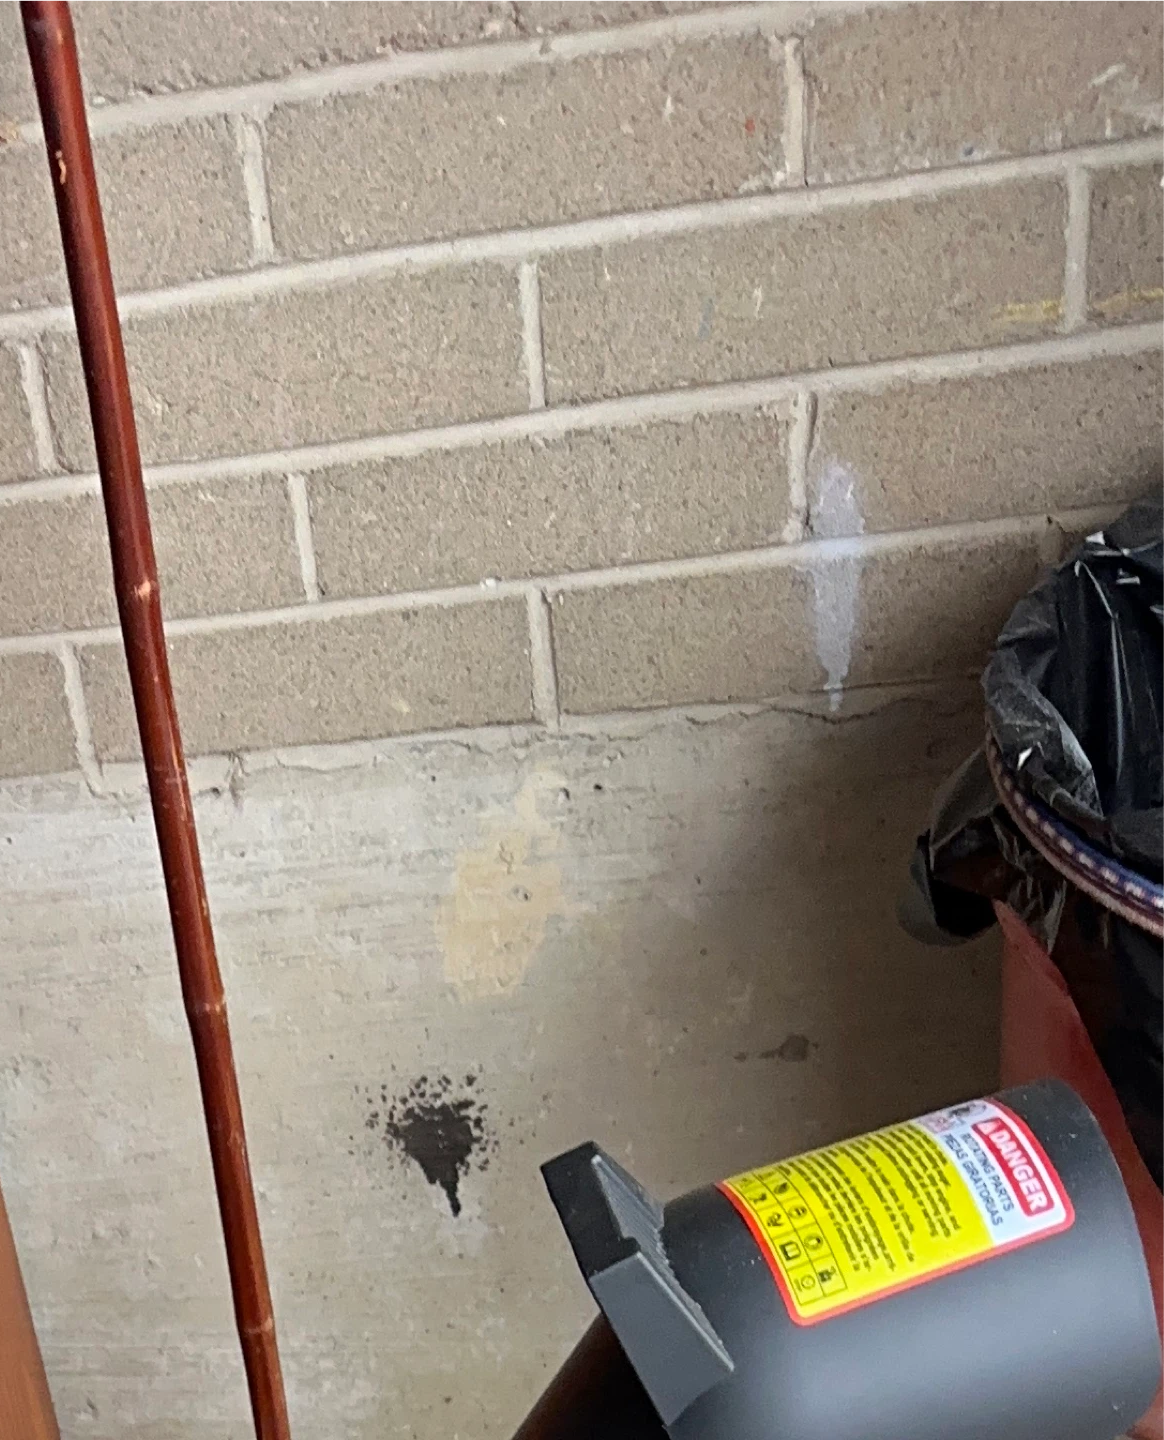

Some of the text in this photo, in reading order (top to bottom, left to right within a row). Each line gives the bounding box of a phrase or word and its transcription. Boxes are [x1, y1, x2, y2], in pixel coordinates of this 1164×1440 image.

[963, 1161, 1004, 1226] GIRATORIAS
[988, 1129, 1048, 1213] DANGER
[989, 1176, 1015, 1212] PARTS
